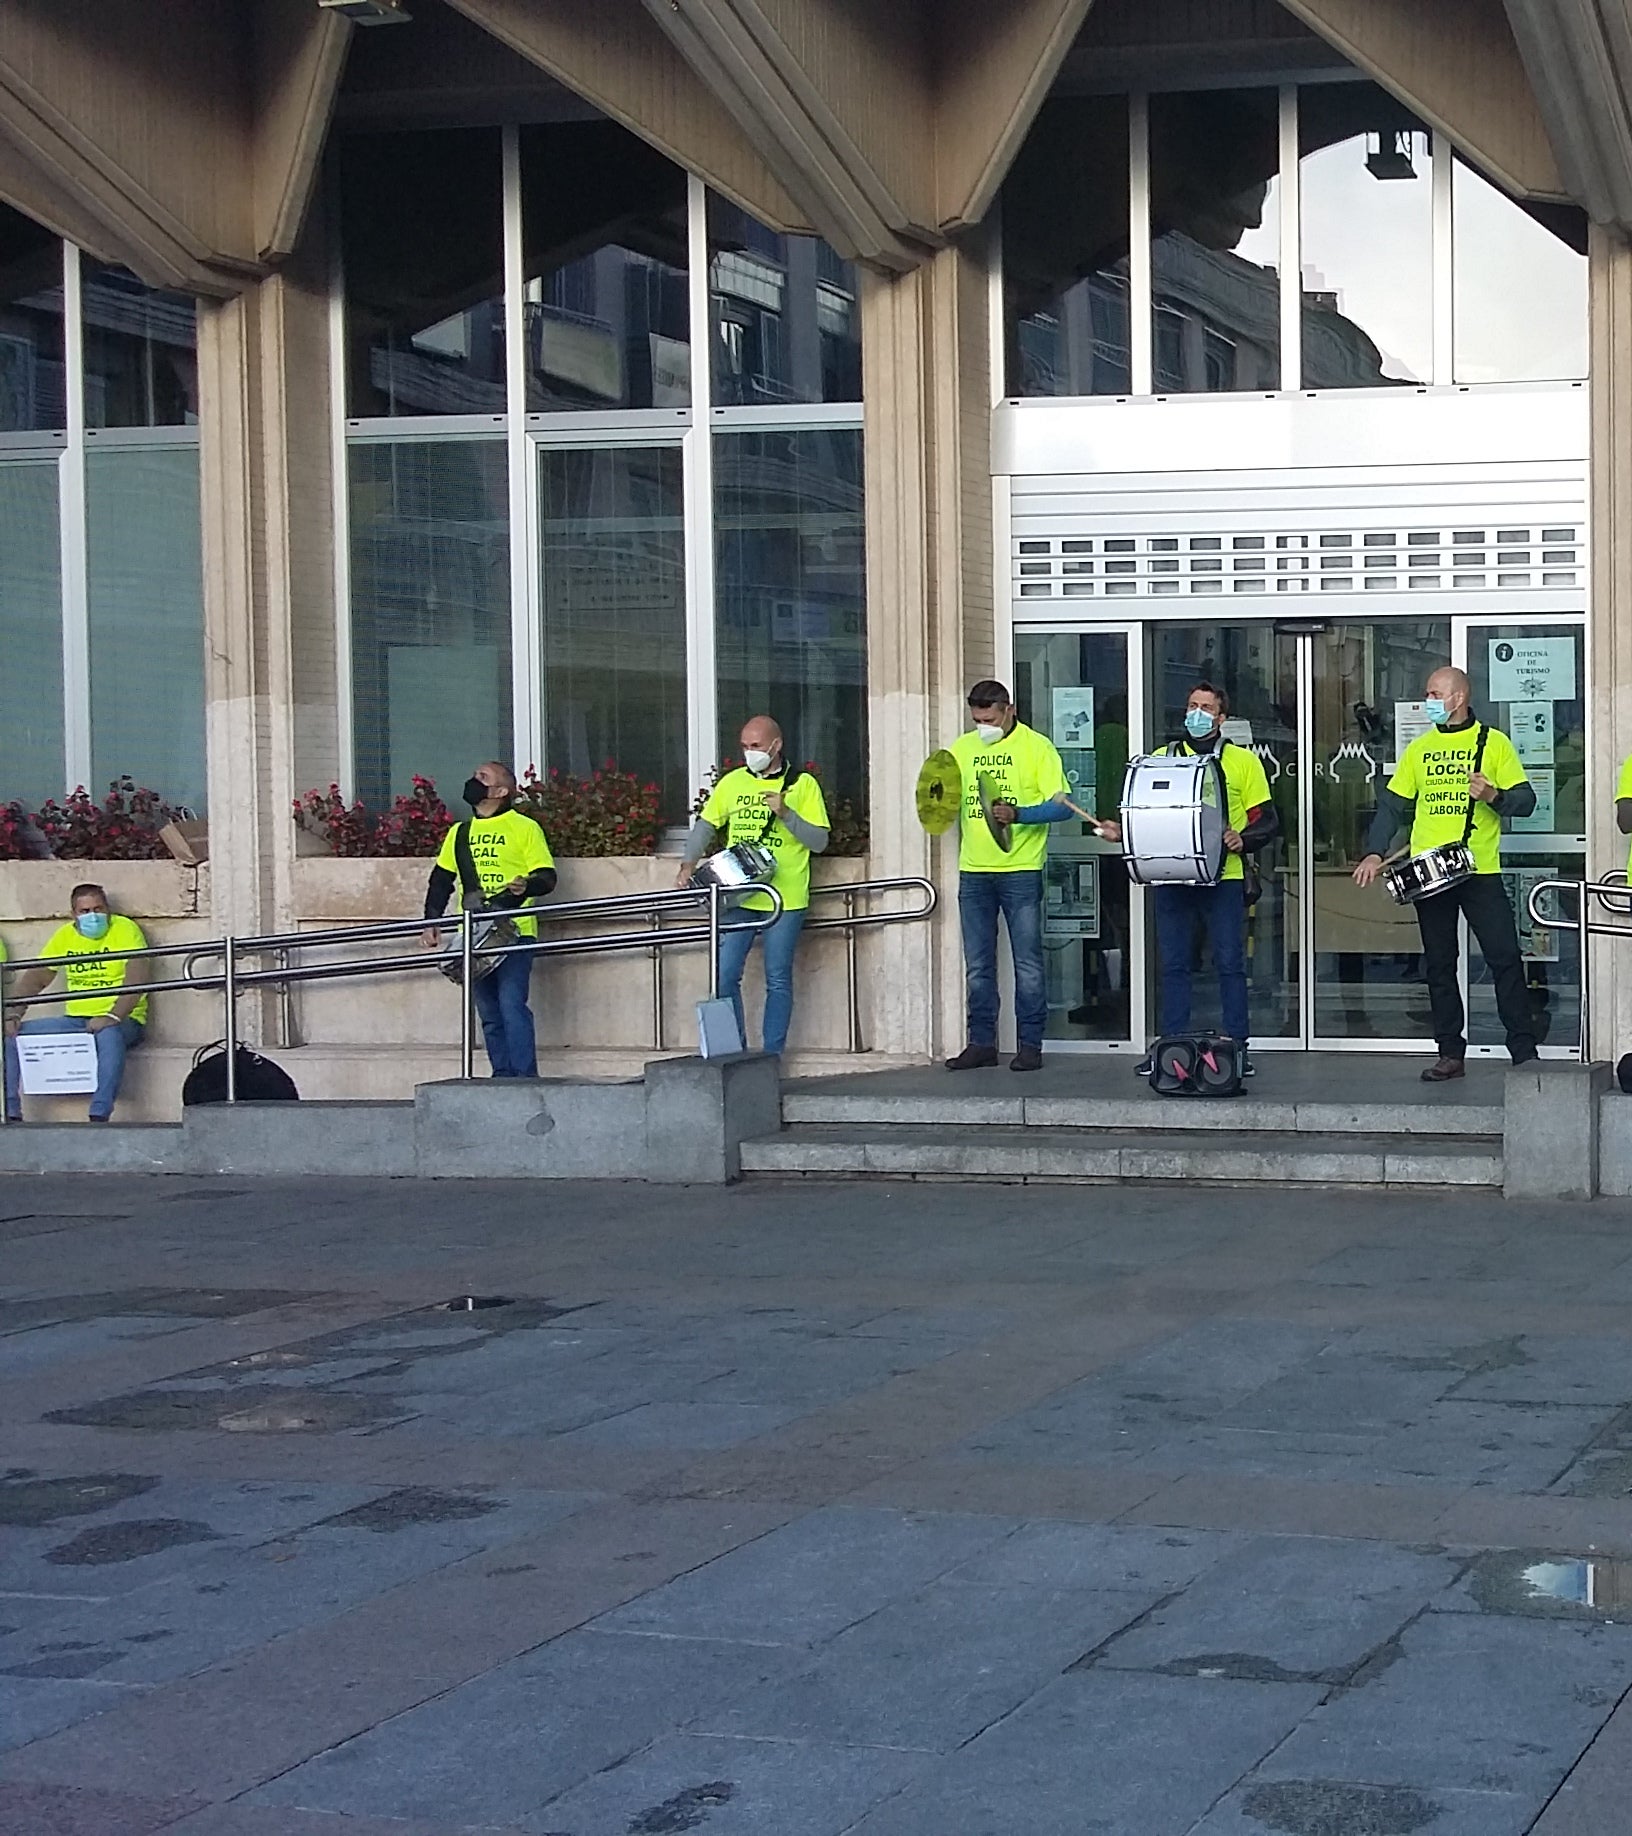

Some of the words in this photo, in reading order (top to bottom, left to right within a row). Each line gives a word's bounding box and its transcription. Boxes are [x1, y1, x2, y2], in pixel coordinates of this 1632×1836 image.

[973, 752, 1013, 767] POLICÍA
[976, 769, 1007, 780] LCAL
[1425, 778, 1455, 786] CIUDAD
[736, 795, 768, 807] POLIC
[1425, 791, 1469, 803] CONFLIC
[1429, 805, 1469, 816] LABORA
[469, 832, 506, 846] LICÍA
[472, 847, 499, 859] CAL
